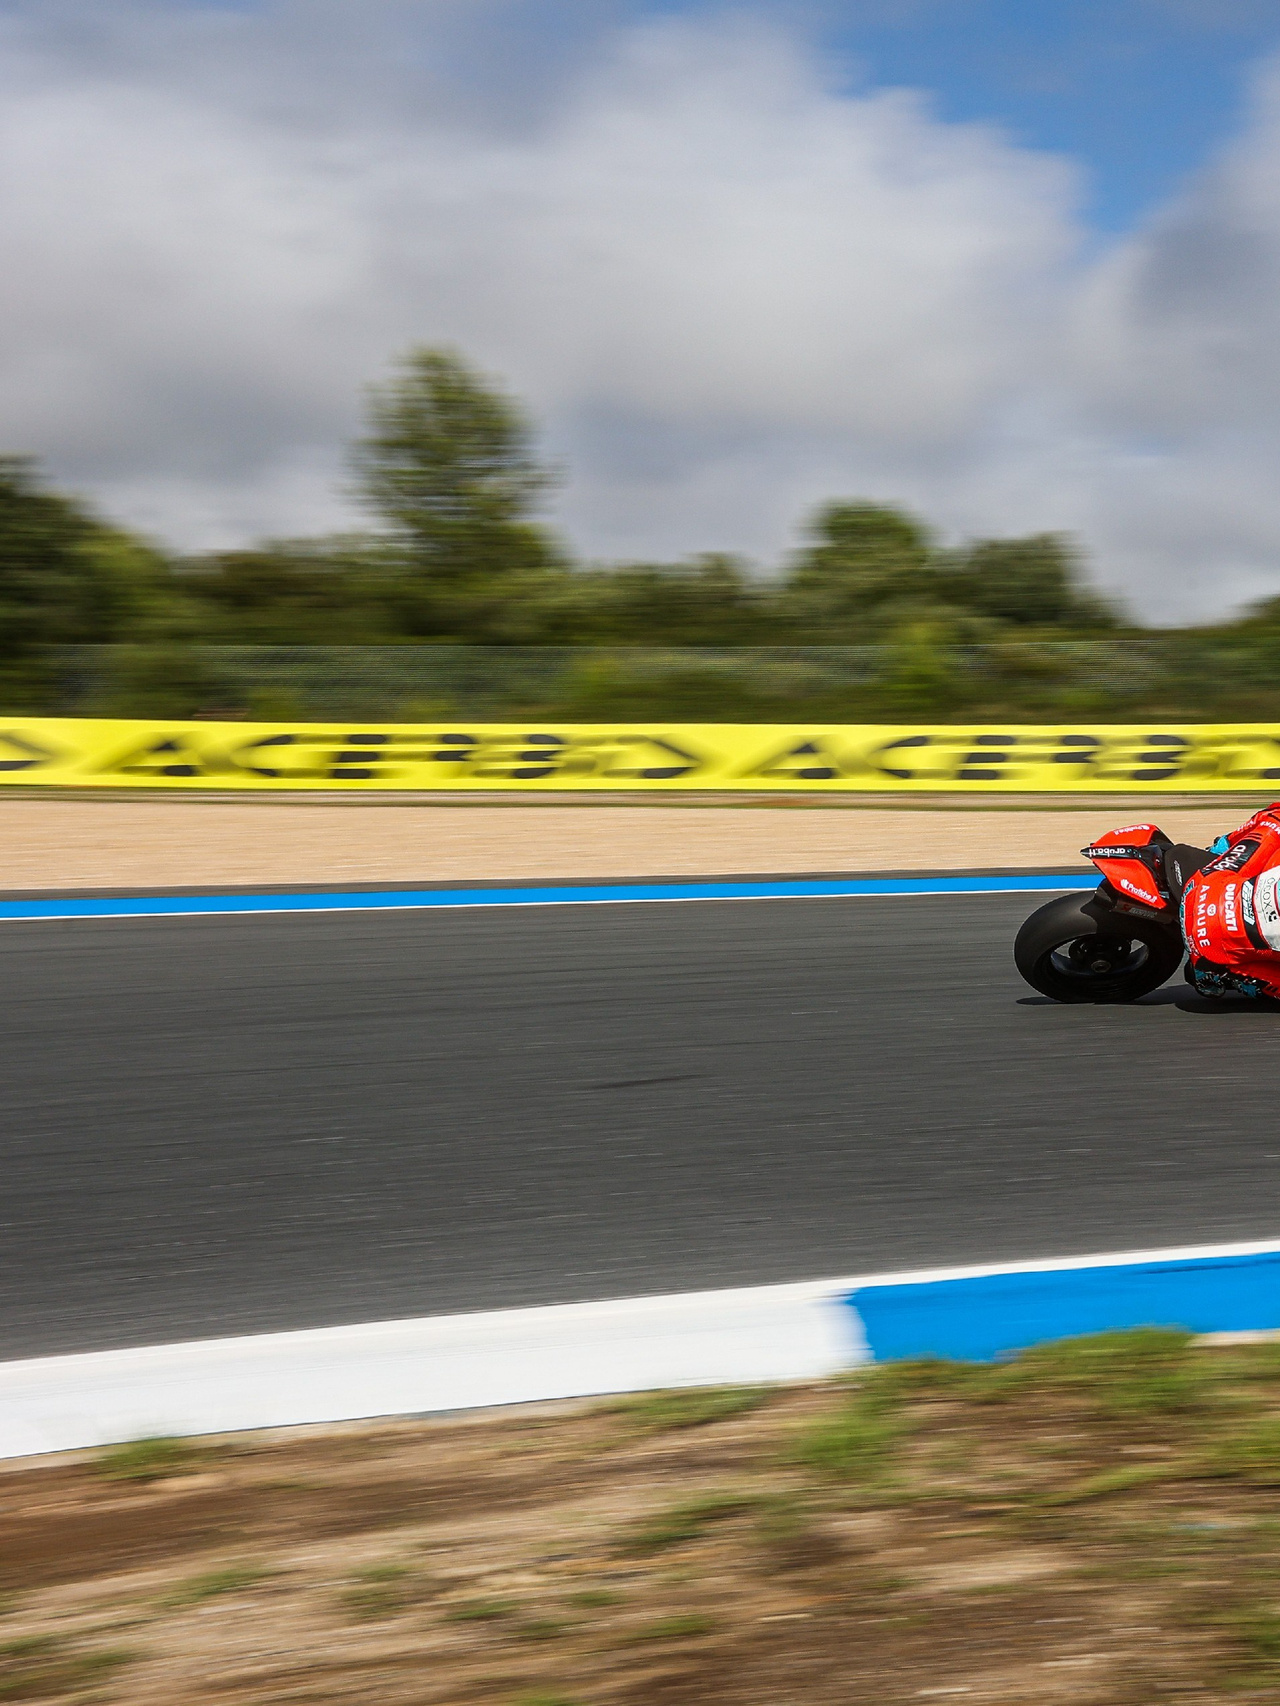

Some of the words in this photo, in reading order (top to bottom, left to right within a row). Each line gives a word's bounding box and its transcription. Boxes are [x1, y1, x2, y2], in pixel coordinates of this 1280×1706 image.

[1089, 848, 1125, 857] aruba.it
[1197, 885, 1210, 947] ARMURE
[1225, 884, 1238, 931] DUCATI
